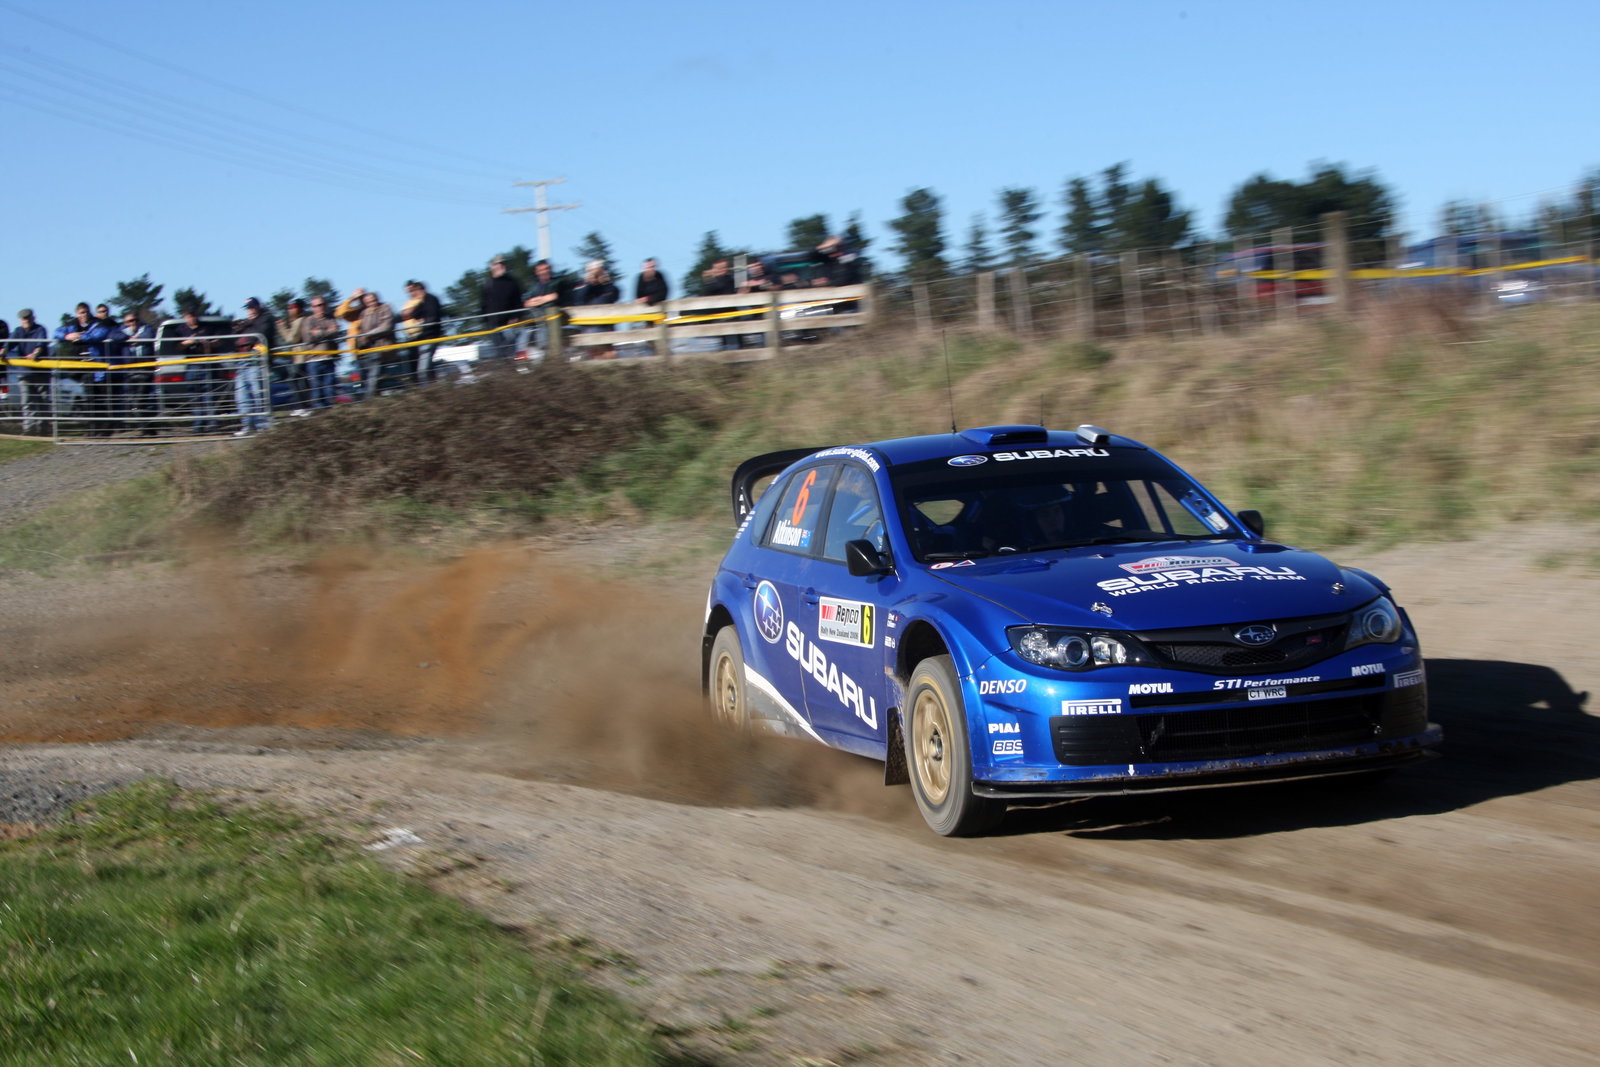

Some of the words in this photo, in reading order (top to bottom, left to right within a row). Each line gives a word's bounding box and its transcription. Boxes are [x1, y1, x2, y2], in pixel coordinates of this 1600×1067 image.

[993, 448, 1110, 462] SUBARU
[792, 470, 816, 527] 6
[772, 519, 802, 546] Atkinson
[1096, 566, 1298, 591] SUBARU
[1108, 581, 1180, 597] WORLD
[1187, 575, 1245, 585] RALLY
[836, 604, 859, 626] Repco
[863, 605, 871, 645] 6
[786, 621, 877, 730] SUBARU
[1351, 663, 1386, 676] MOTUL
[980, 679, 1027, 695] DENSO
[1128, 682, 1174, 695] MOTUL
[1213, 679, 1242, 690] STI
[1243, 675, 1321, 688] Performance
[1263, 687, 1285, 698] WRC
[1062, 699, 1122, 715] PIRELLI
[993, 740, 1023, 754] BBS
